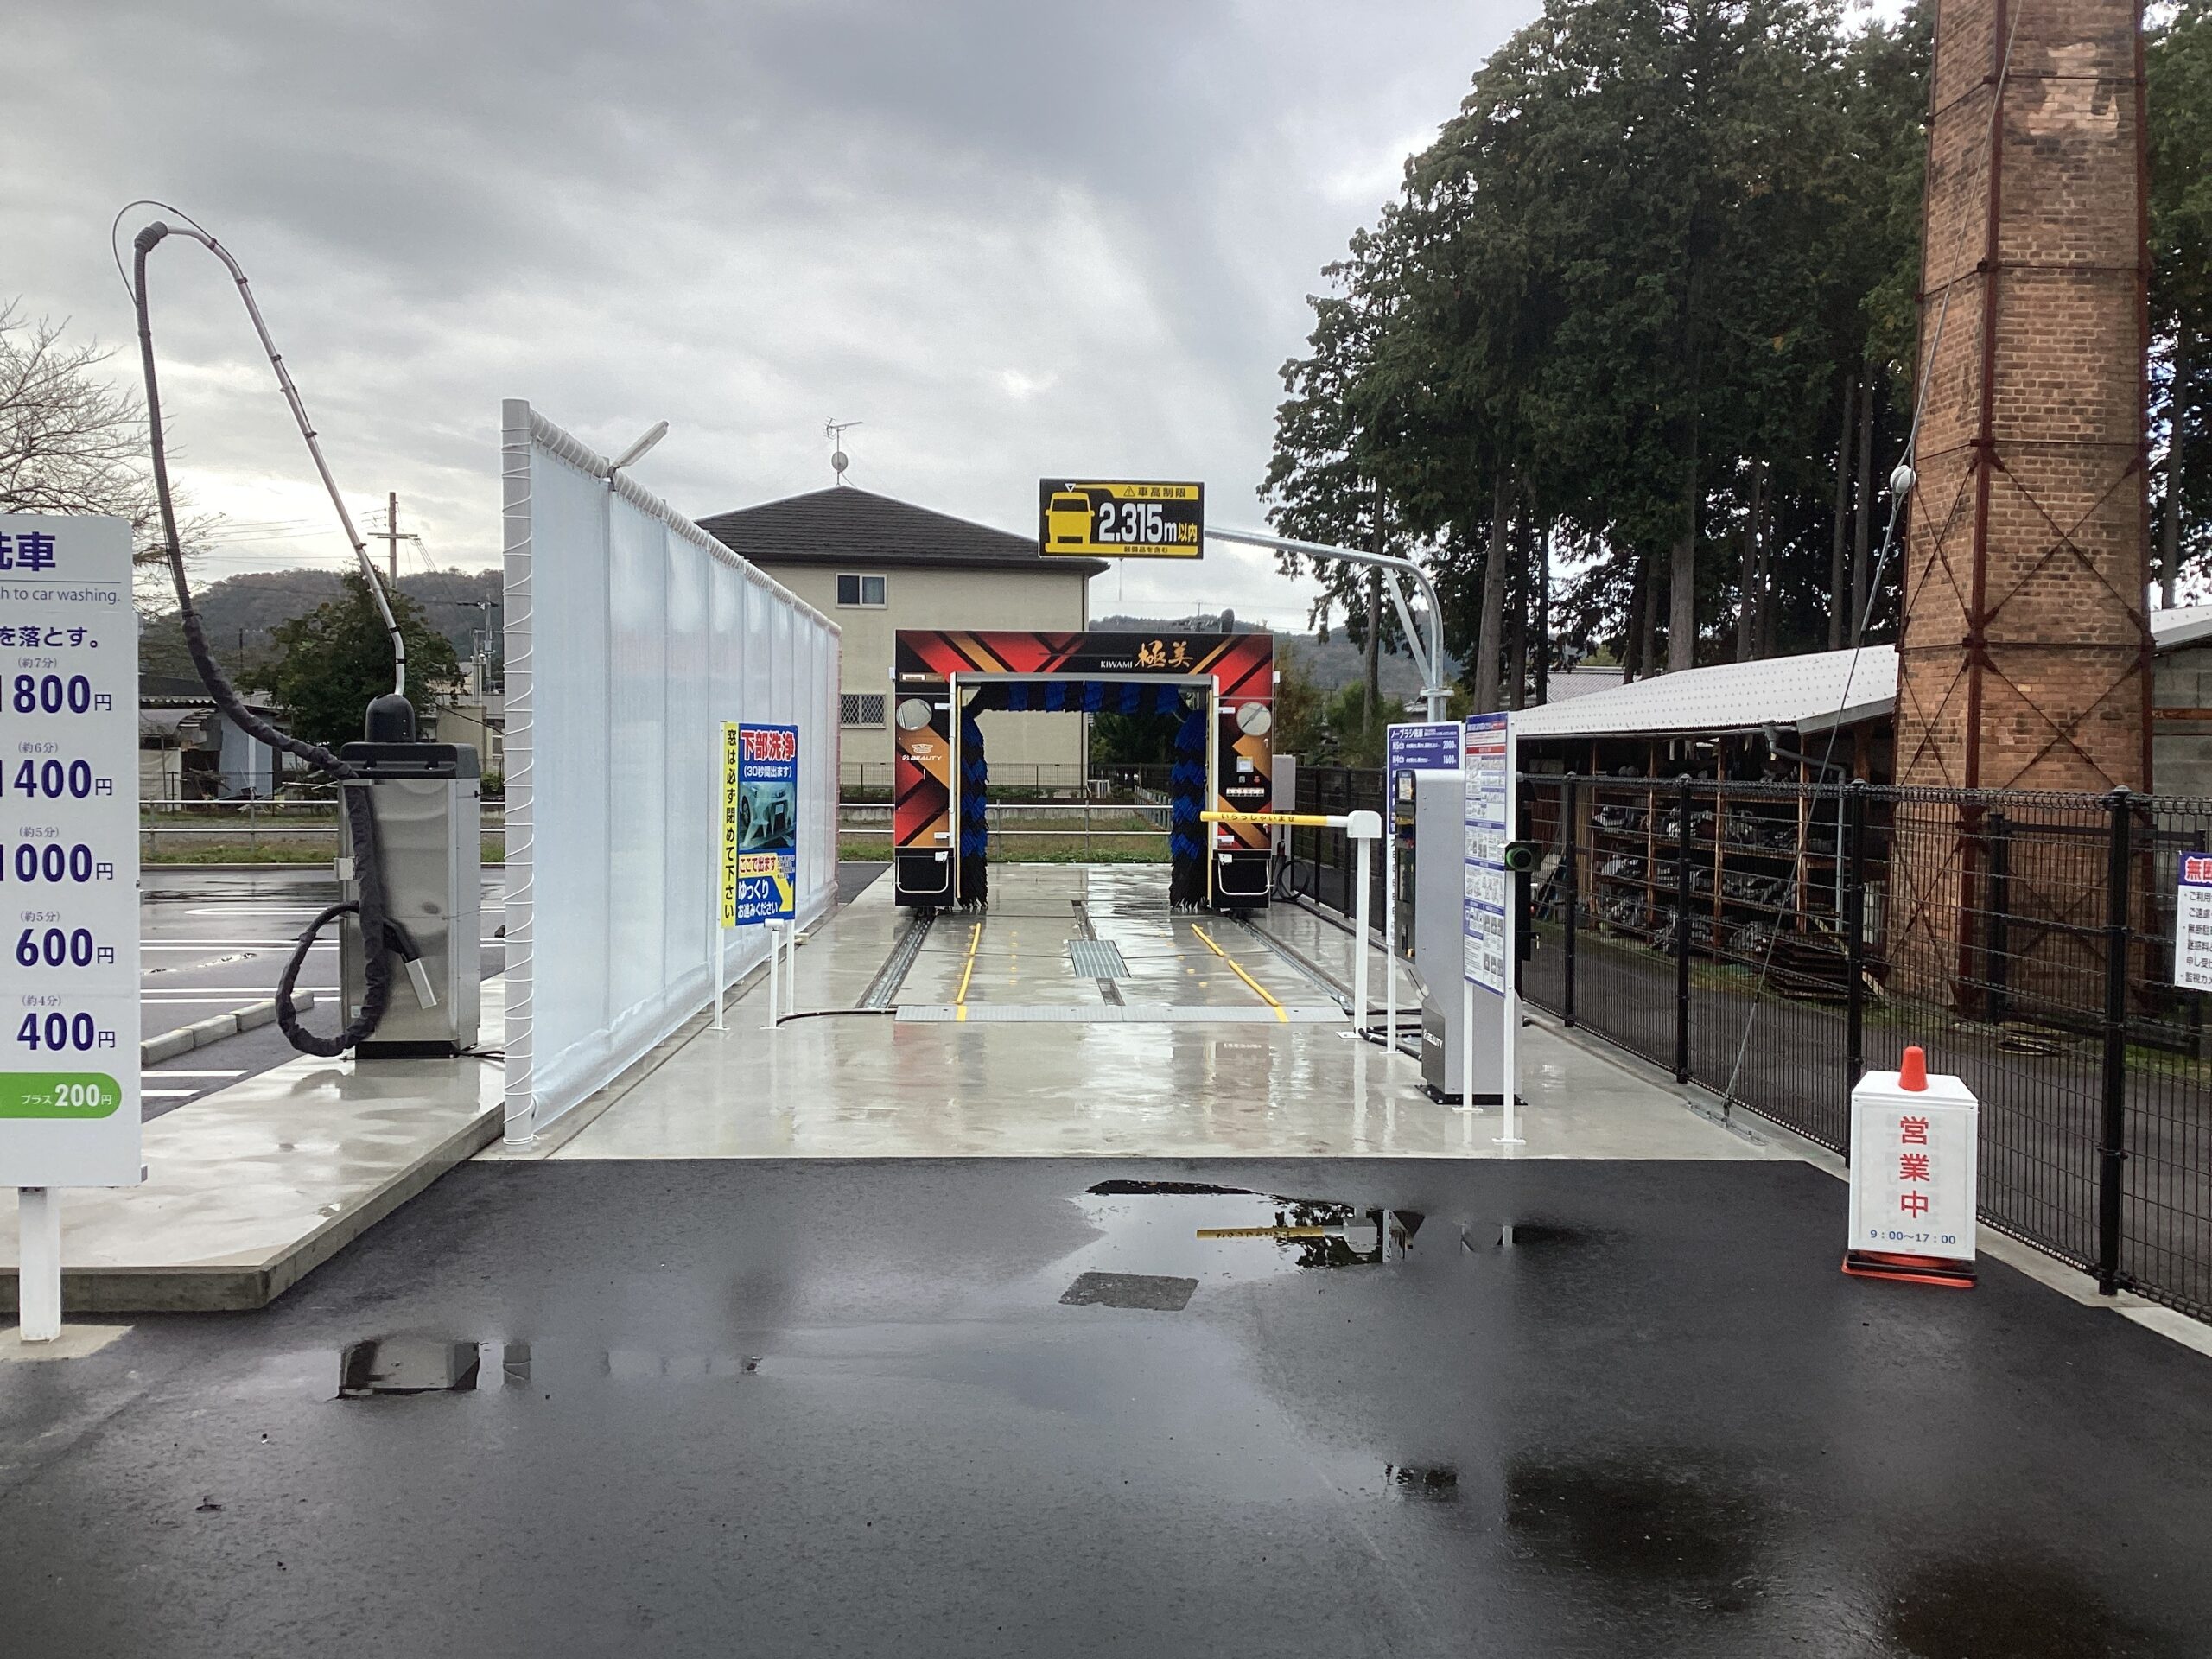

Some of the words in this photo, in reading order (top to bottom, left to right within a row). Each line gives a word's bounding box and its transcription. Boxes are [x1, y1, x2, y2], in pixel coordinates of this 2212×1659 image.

[1138, 486, 1185, 499] 車高制限
[14, 588, 29, 601] to
[32, 589, 54, 601] car
[57, 588, 121, 605] washing.
[0, 626, 98, 648] を落とす。
[18, 657, 57, 669] (約7分)
[1100, 660, 1133, 669] KIWAMI
[0, 674, 112, 715] 800円
[18, 741, 58, 753] (約6分)
[741, 730, 795, 761] 下部洗浄
[0, 760, 113, 798] 400円
[724, 729, 736, 918] 窓は必ず閉めて下さい
[1222, 813, 1294, 823] いらっしゃいませ
[19, 826, 60, 839] (約5分)
[0, 843, 114, 883] 000円
[740, 856, 776, 873] ここで出ます
[738, 879, 769, 900] ゆっくり
[2190, 891, 2212, 903] ご利用
[20, 911, 60, 923] (約5分)
[2189, 907, 2212, 919] ご遠慮
[2188, 923, 2212, 936] 無断駐
[22, 995, 61, 1007] (約4分)
[1899, 1116, 1930, 1219] 営業中
